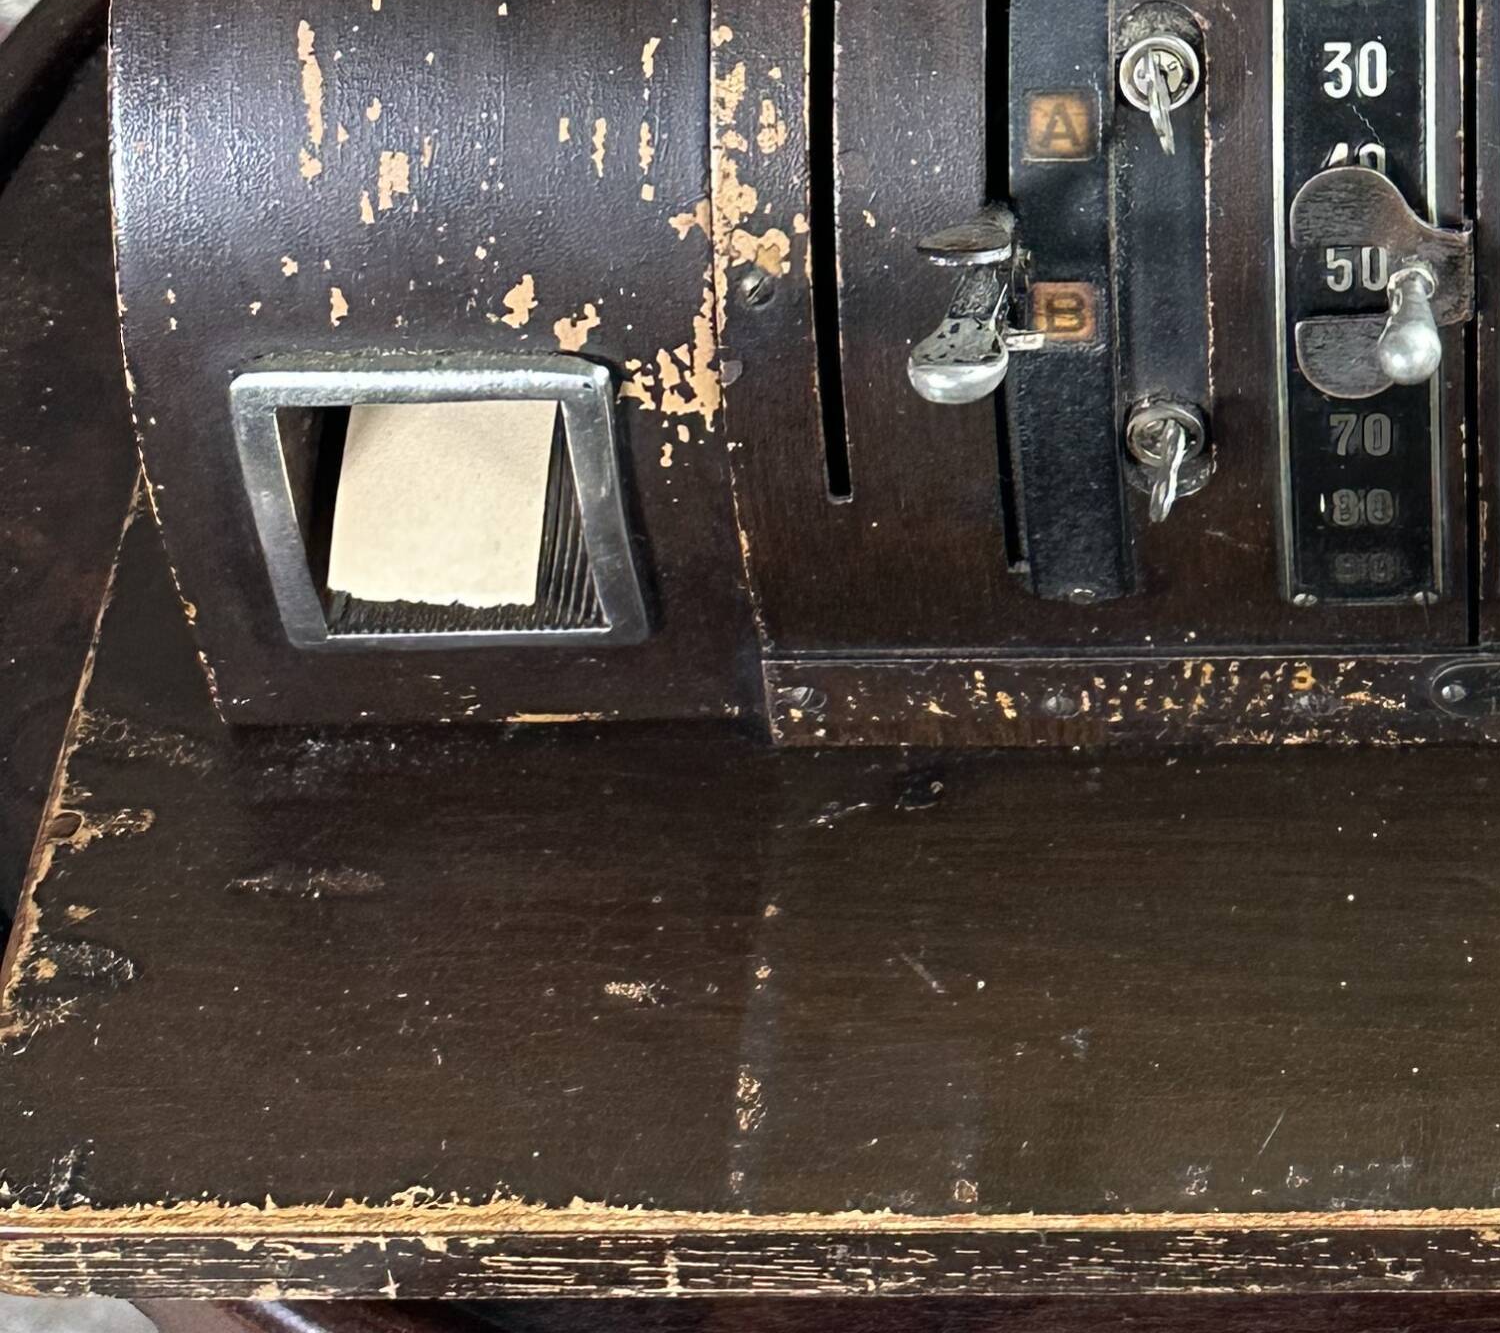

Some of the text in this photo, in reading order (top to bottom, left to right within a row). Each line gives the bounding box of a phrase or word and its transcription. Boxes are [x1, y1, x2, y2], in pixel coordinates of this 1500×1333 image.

[1322, 40, 1388, 98] 30
[1043, 102, 1080, 149] A
[1325, 247, 1388, 292] 50
[1047, 291, 1085, 331] B
[1329, 413, 1393, 457] 70
